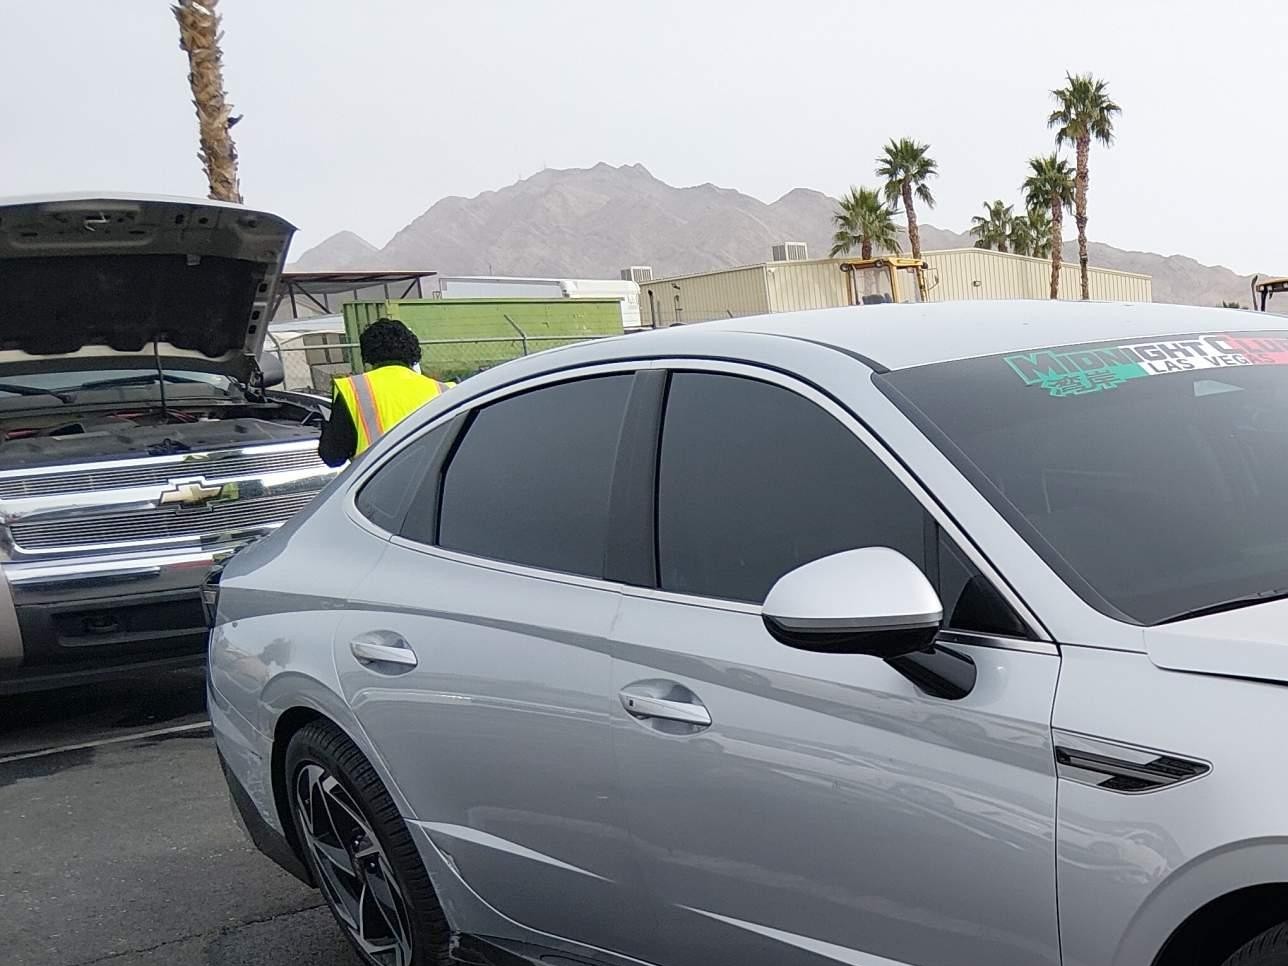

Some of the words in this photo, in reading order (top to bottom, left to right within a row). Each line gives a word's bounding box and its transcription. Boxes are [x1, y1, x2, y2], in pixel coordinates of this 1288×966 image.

[1004, 339, 1208, 384] MIDNIGHT
[1148, 357, 1195, 374] LAS
[1203, 352, 1273, 368] VEGAS
